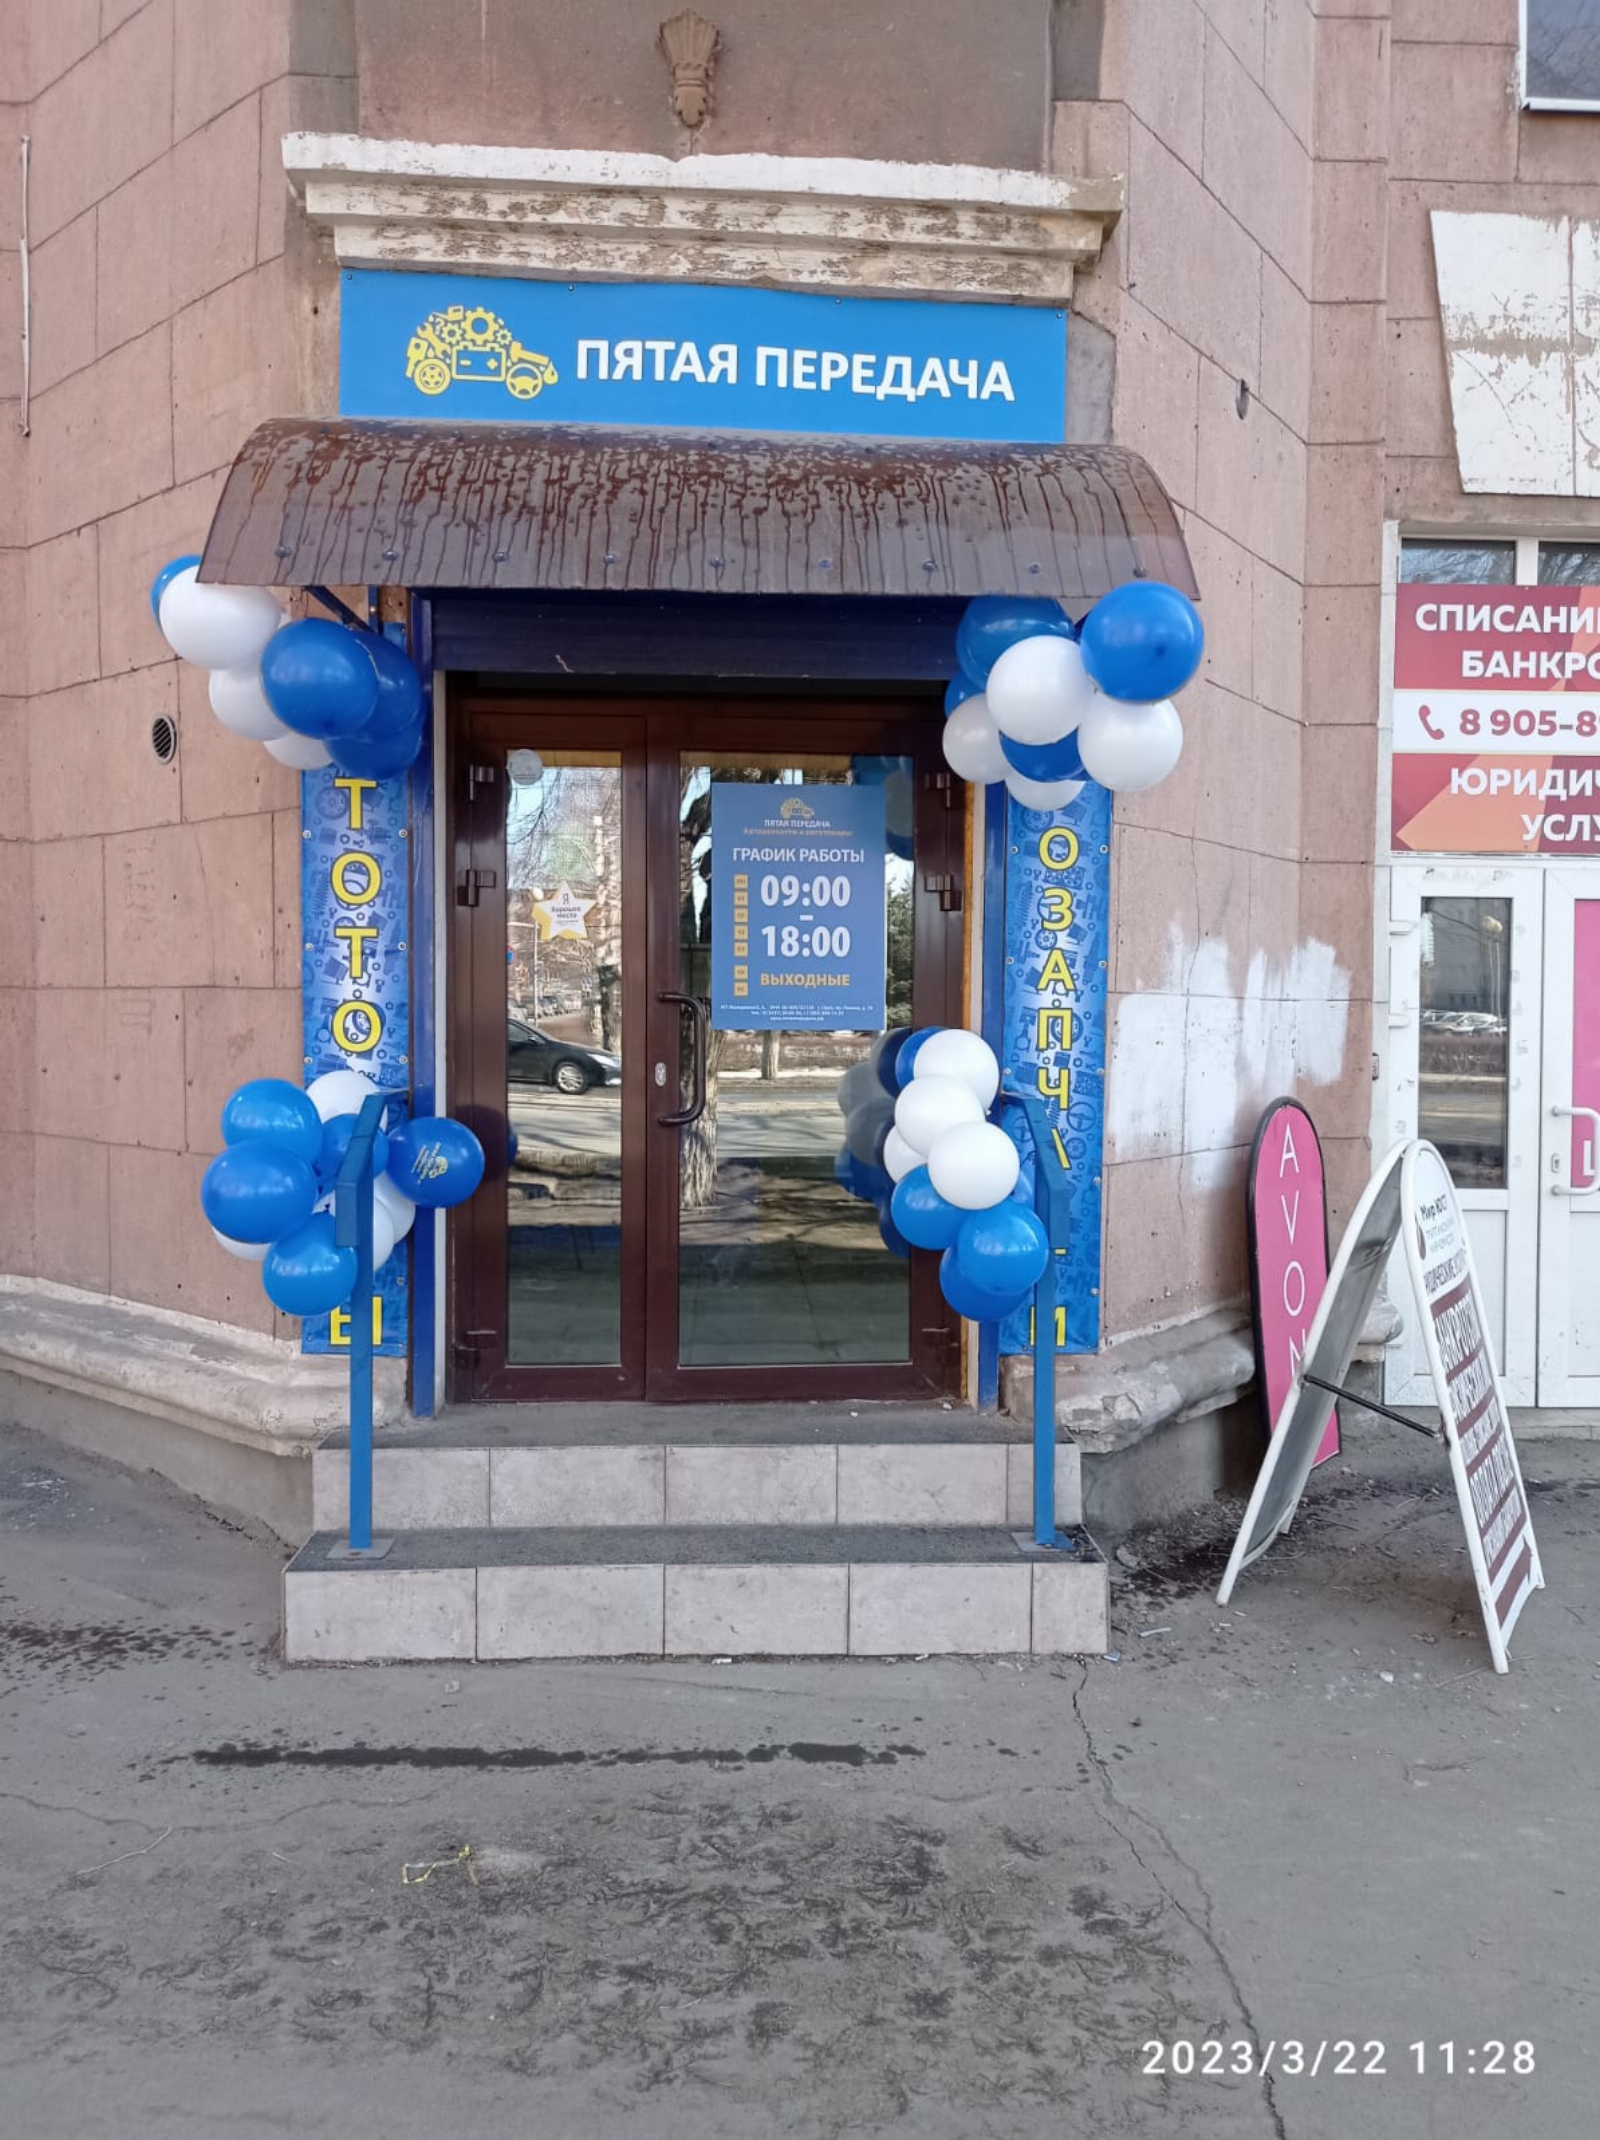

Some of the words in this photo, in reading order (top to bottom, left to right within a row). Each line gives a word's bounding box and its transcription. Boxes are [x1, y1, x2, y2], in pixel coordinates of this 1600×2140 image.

[577, 339, 738, 384] ПЯТАЯ
[756, 346, 1015, 402] ПЕРЕДАЧА
[1415, 604, 1600, 634] СПИСАНИ
[1459, 709, 1480, 736] 8
[1490, 709, 1600, 738] 905-8
[1451, 768, 1600, 802] ЮРИДИ
[764, 819, 789, 828] ПЯТАЯ
[791, 819, 831, 829] ПЕРЕДАЧА
[732, 847, 796, 862] ГРАФИК
[799, 848, 865, 863] РАБОТЫ
[760, 874, 851, 907] 09:00
[761, 925, 851, 958] 18:00
[760, 973, 851, 989] ВЫХОДНЫЕ
